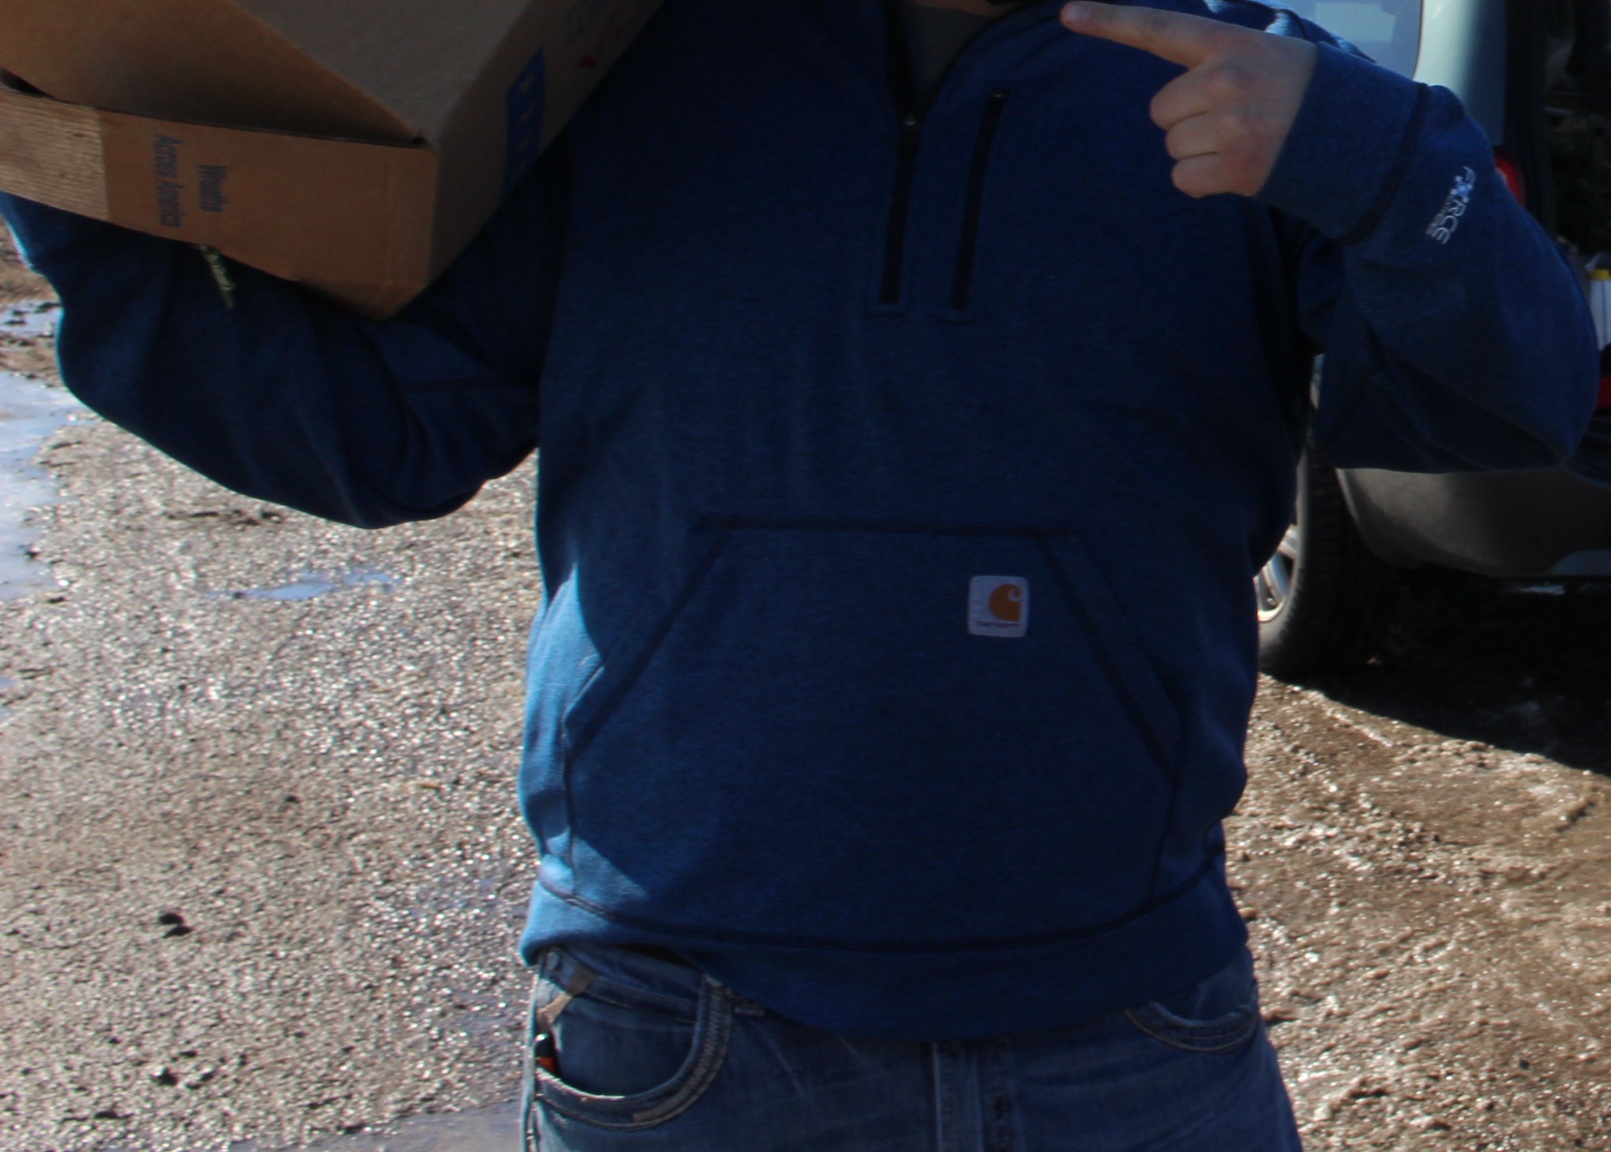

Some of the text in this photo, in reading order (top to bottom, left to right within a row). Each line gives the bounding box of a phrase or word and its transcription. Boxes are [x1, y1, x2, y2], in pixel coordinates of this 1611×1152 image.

[154, 135, 185, 228] Across America
[198, 165, 227, 213] Wreaths
